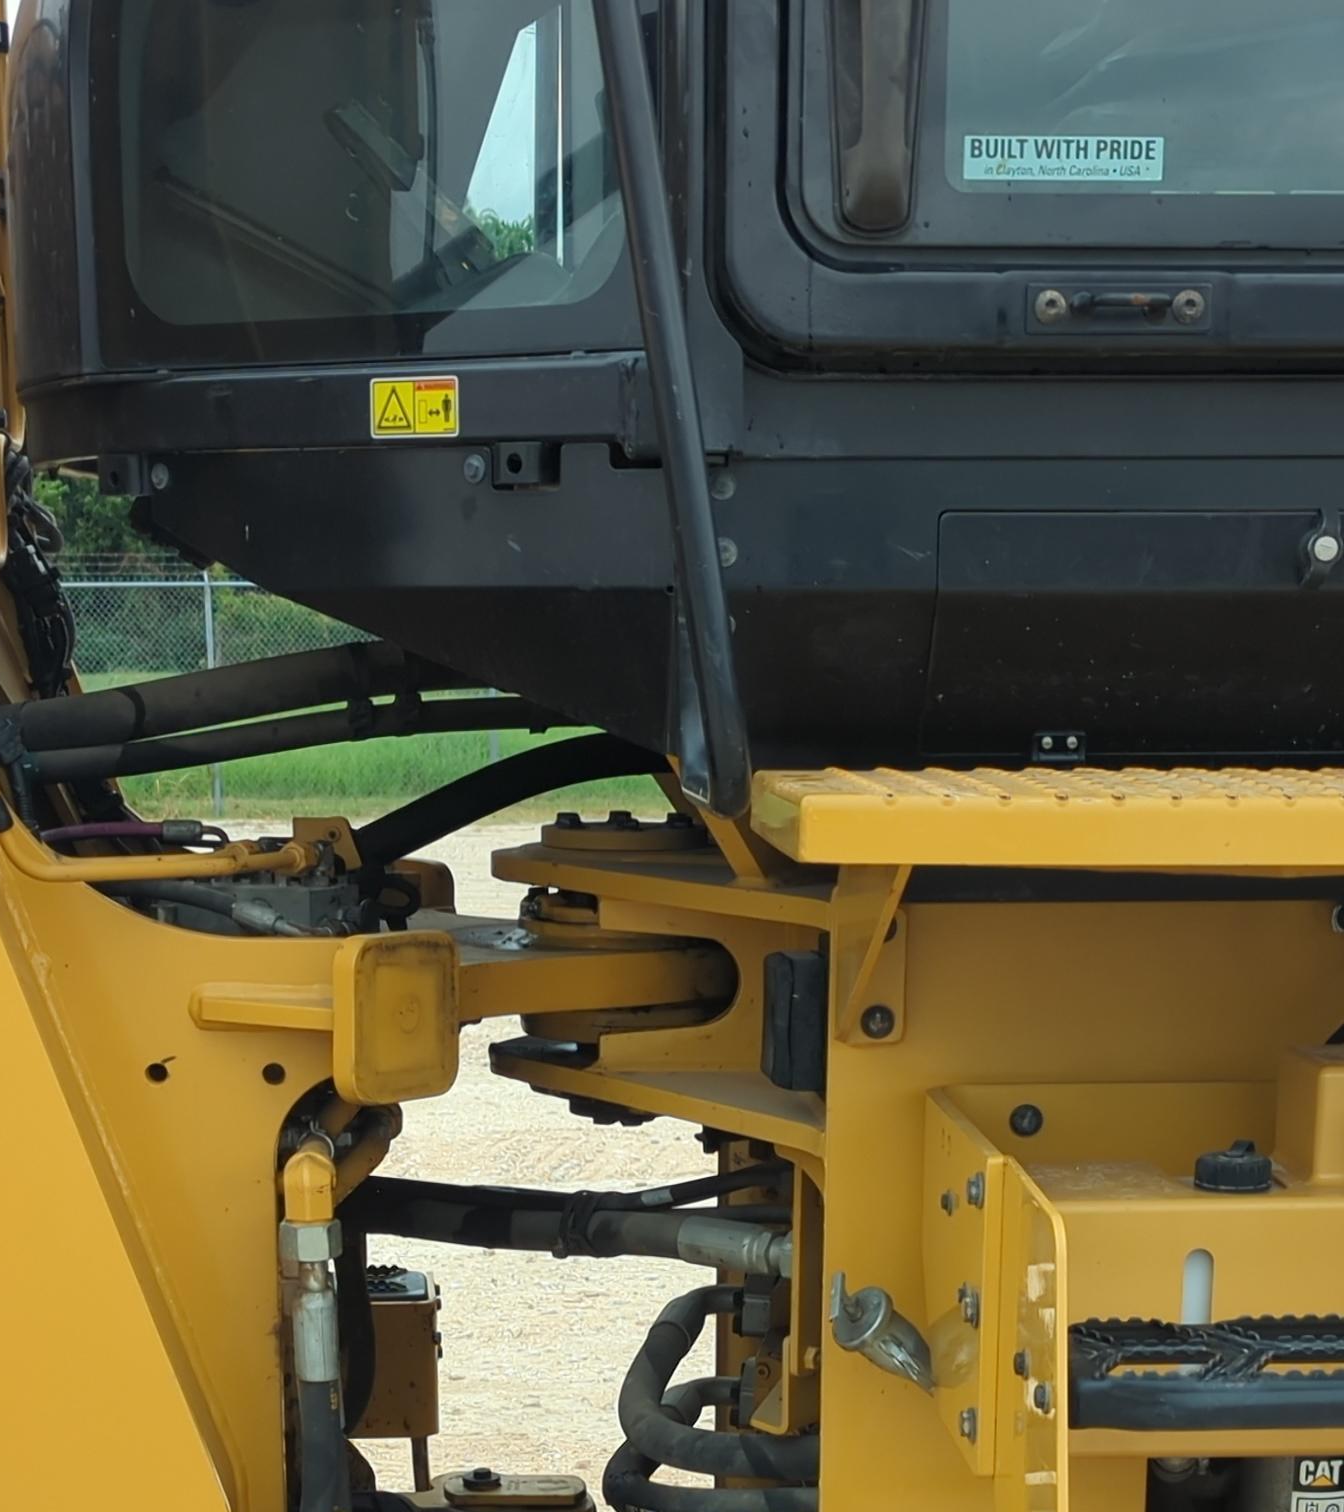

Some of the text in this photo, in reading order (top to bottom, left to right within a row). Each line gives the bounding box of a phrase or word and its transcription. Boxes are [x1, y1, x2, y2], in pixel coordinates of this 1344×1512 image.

[970, 138, 1157, 160] BUILT WITH PRIDE
[984, 165, 993, 175] in
[1038, 165, 1066, 176] North
[1069, 165, 1109, 176] Carolina
[1119, 166, 1141, 176] USA
[1299, 1459, 1344, 1486] CAT
